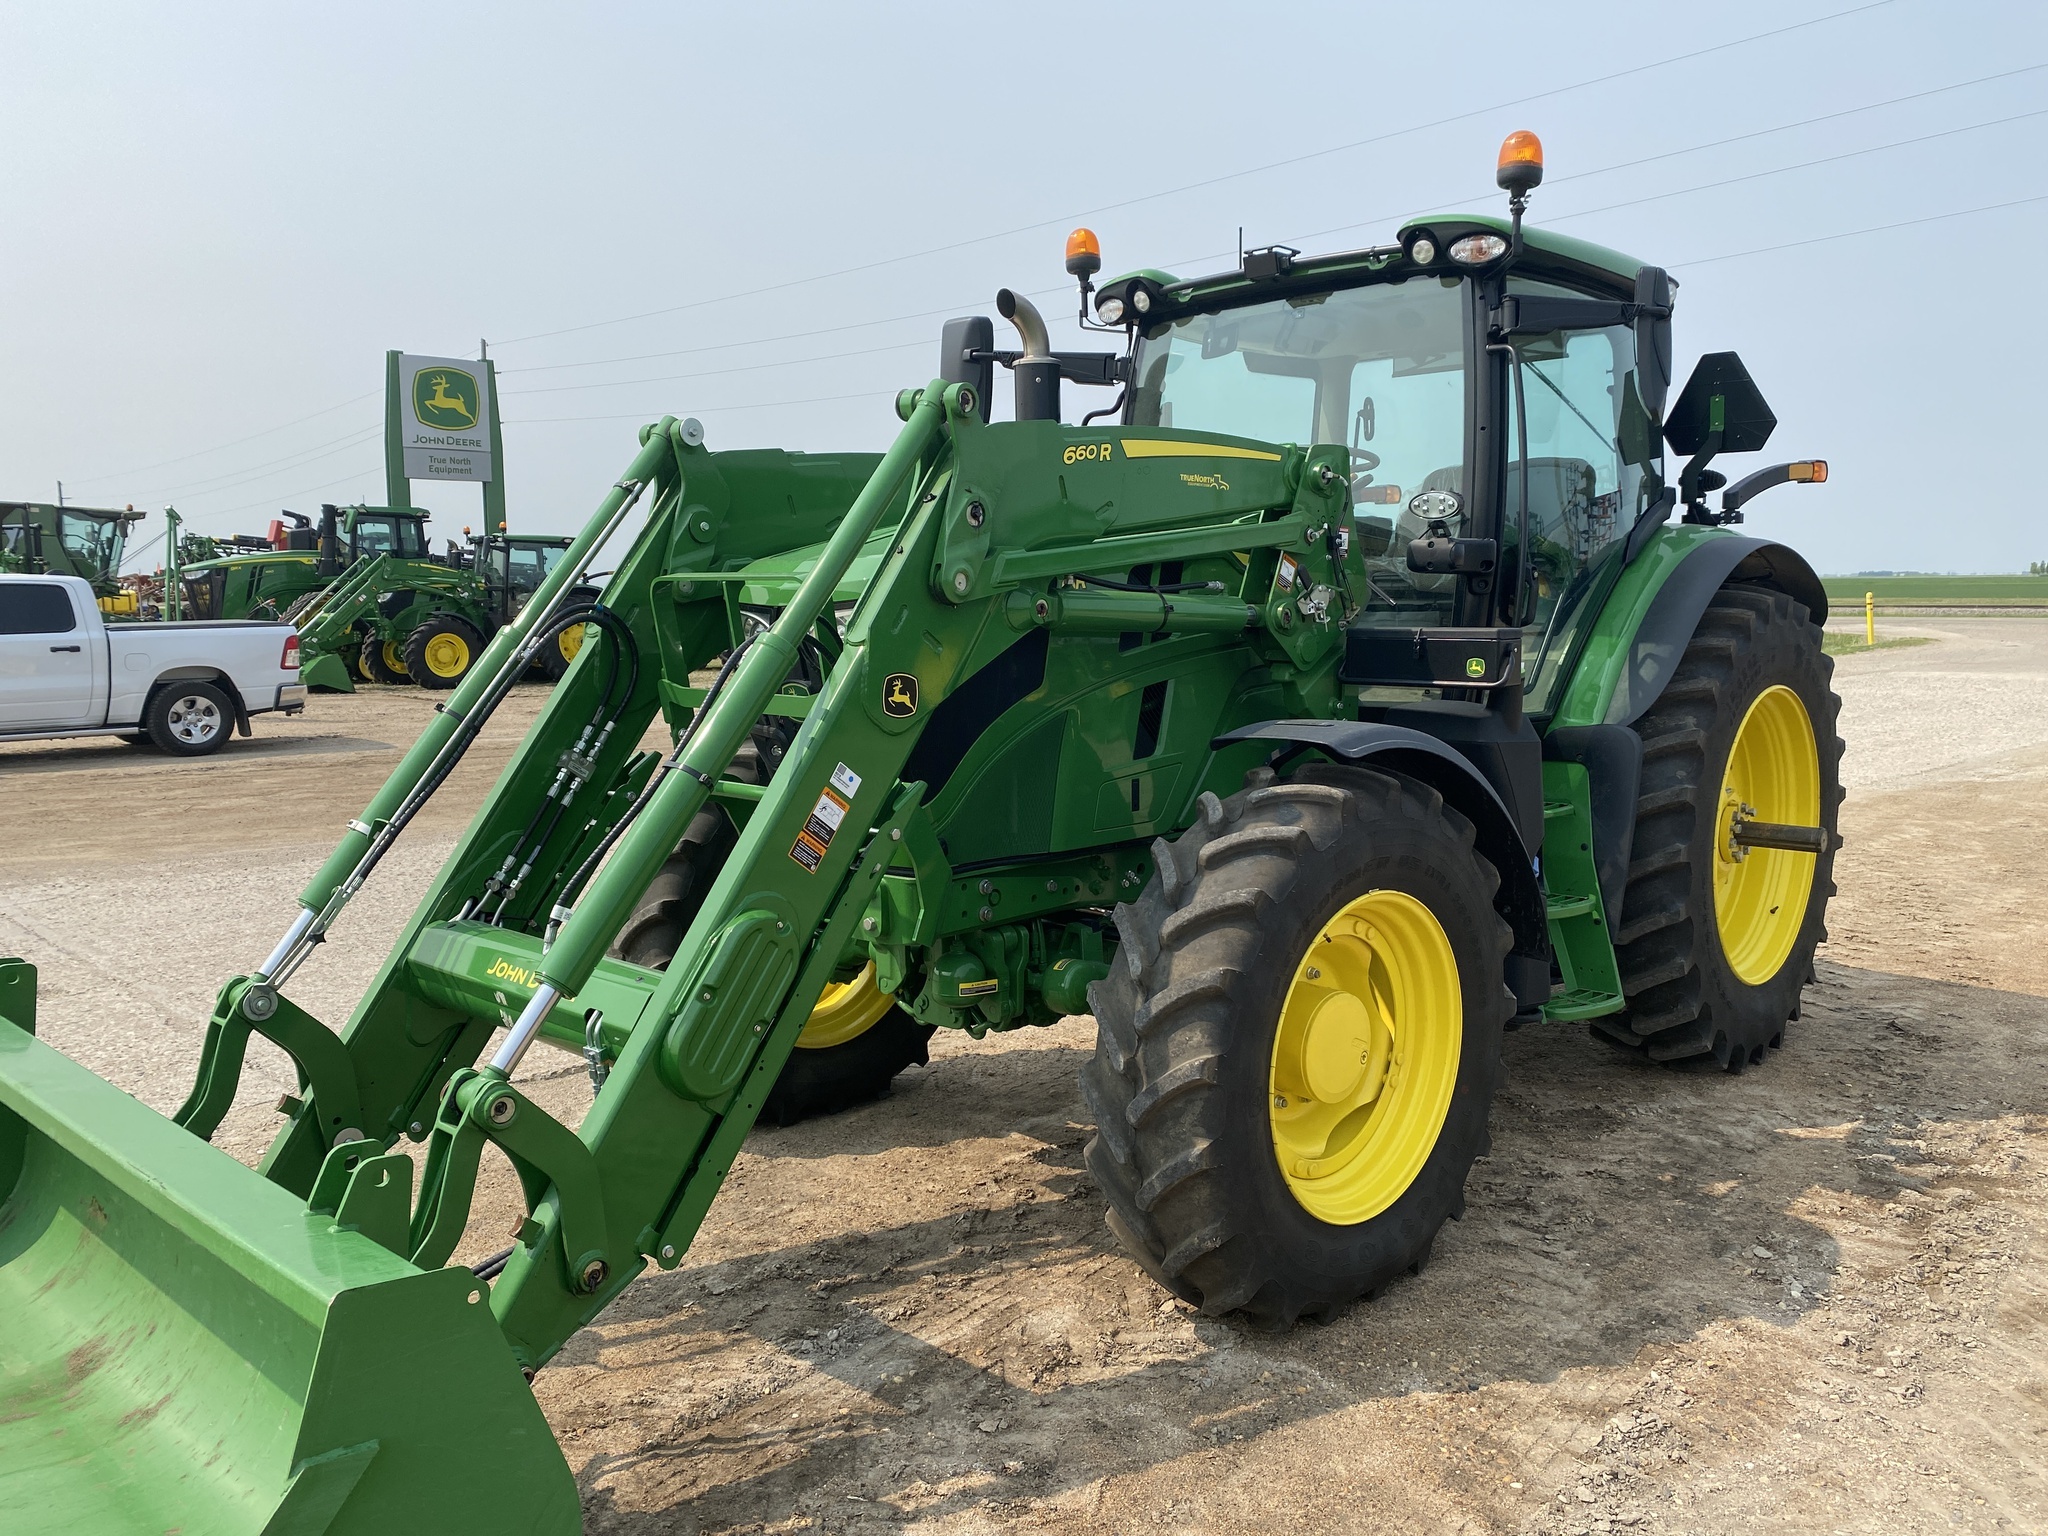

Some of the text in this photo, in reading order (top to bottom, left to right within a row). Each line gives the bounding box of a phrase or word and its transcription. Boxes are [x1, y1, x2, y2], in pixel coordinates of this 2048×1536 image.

[412, 434, 482, 448] JOHN DEERE
[428, 455, 471, 466] True North
[1062, 442, 1112, 465] 660 R
[428, 465, 472, 475] Equipment
[486, 957, 529, 985] JOHN
